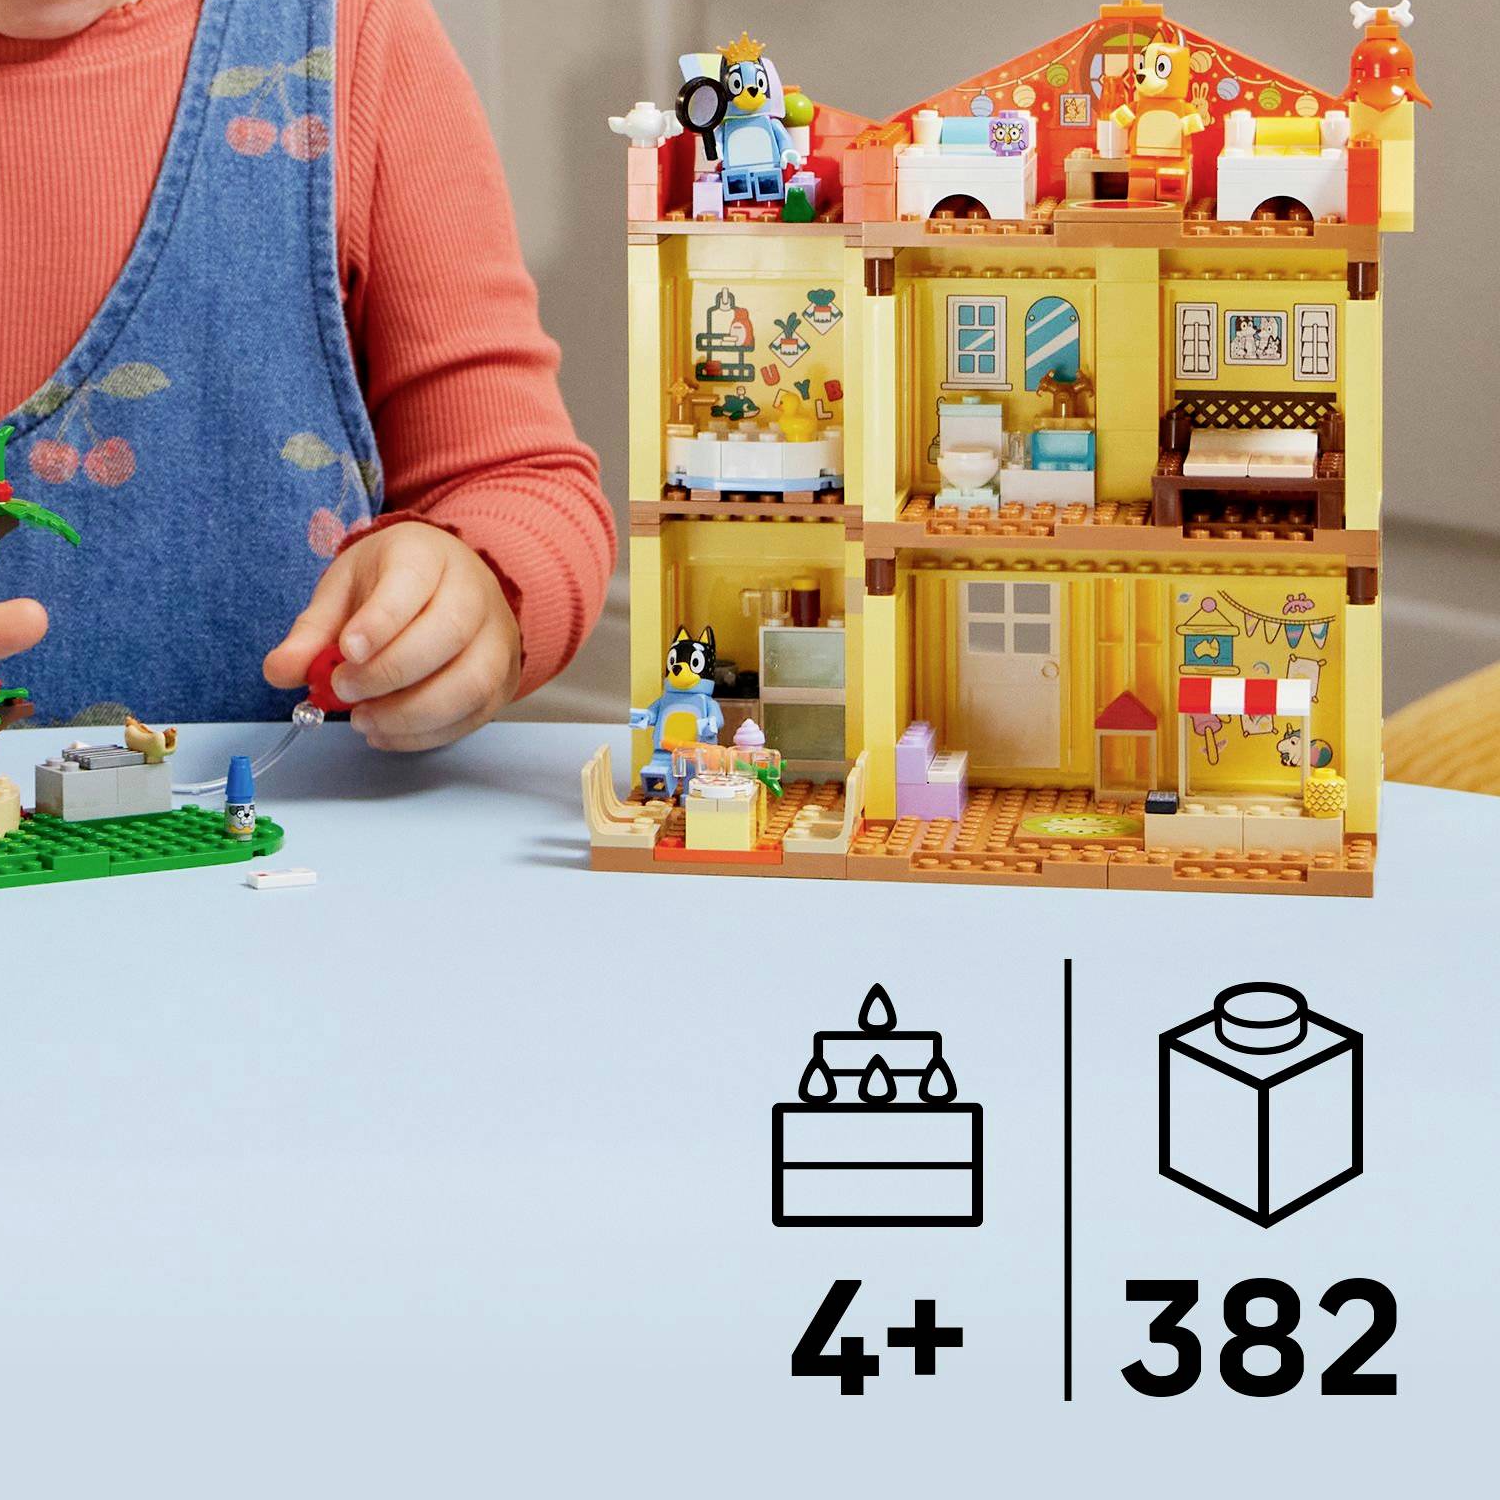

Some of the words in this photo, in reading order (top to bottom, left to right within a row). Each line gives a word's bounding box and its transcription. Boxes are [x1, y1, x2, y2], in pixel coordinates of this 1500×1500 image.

[760, 363, 781, 386] U
[794, 379, 811, 400] Y
[824, 379, 844, 402] B
[815, 398, 833, 420] L
